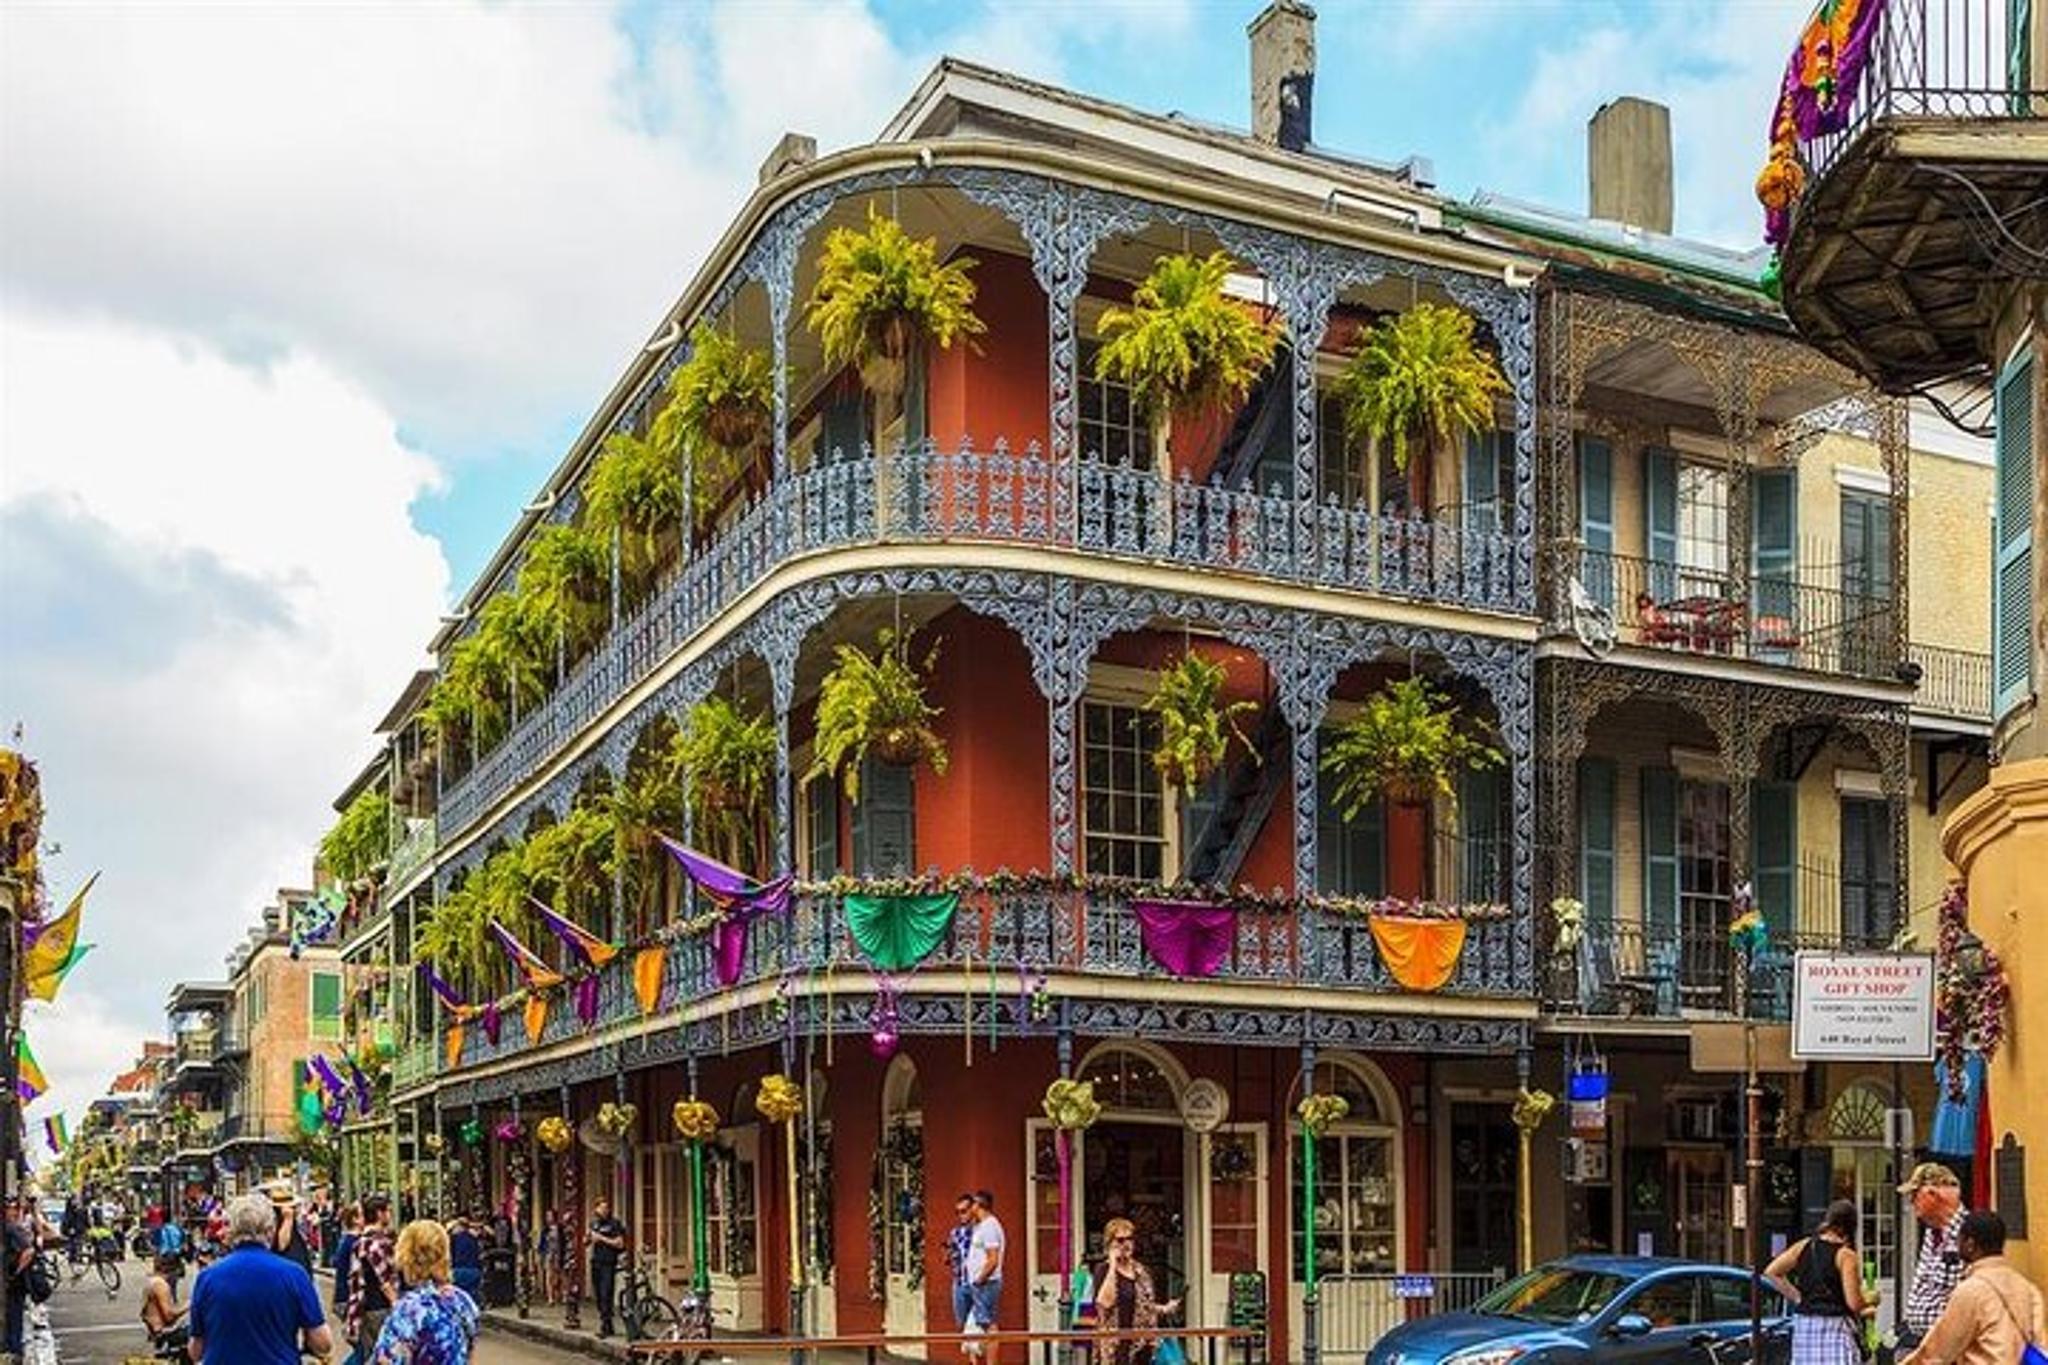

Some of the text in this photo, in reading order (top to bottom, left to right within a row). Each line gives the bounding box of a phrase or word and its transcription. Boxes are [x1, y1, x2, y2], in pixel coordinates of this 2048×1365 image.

[1808, 966, 1923, 977] ROYAL STREET
[1824, 983, 1907, 994] GIFT SHOP
